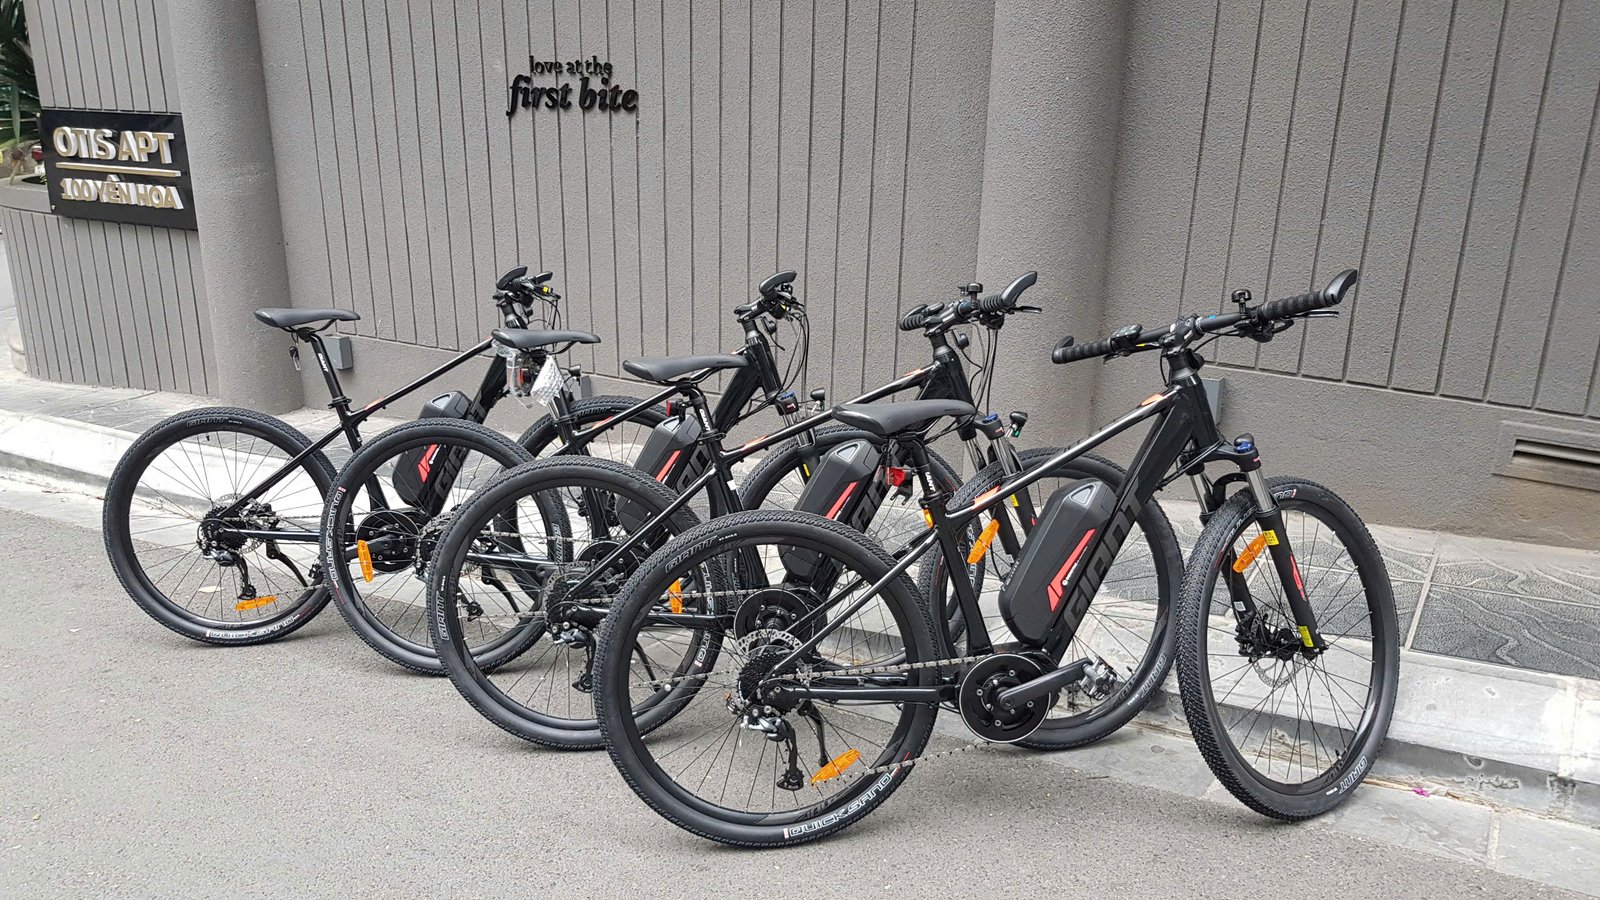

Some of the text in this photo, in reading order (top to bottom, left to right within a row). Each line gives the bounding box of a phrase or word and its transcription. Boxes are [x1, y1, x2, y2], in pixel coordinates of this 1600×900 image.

[529, 55, 613, 74] love at the
[506, 74, 639, 117] first bite
[53, 126, 174, 164] OTIS APT
[60, 178, 98, 202] 100
[95, 174, 138, 205] YÊN
[699, 408, 711, 431] GIANT
[1063, 477, 1149, 636] GIANT
[1338, 755, 1368, 795] GIANT
[789, 772, 893, 837] QUICKSAND
